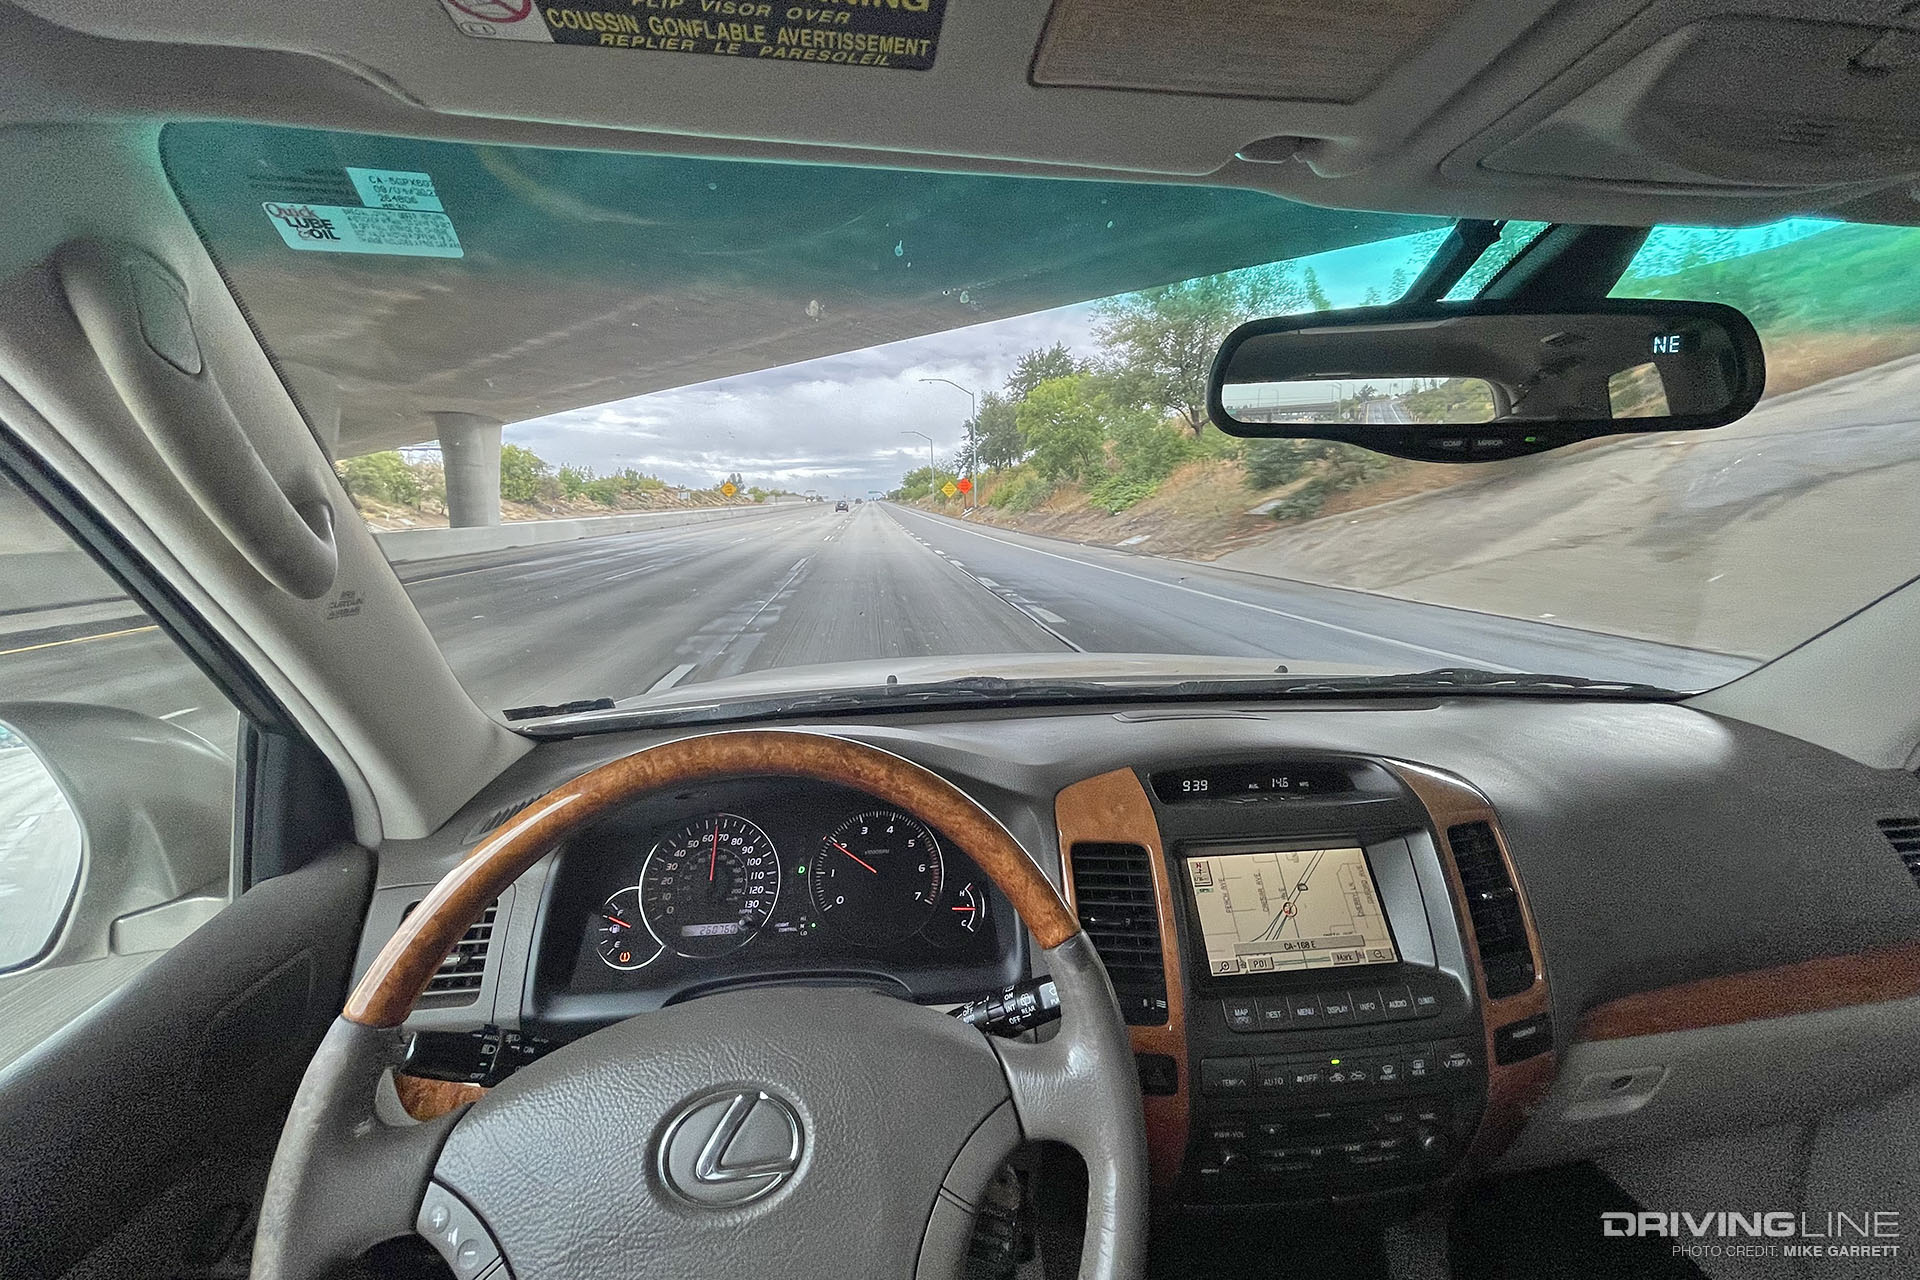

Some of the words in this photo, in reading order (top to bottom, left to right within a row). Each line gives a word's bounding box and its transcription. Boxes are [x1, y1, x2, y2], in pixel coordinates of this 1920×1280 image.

[701, 0, 772, 17] VISOR
[786, 7, 850, 23] OVER
[546, 8, 640, 33] COUSSIN
[650, 16, 766, 42] GONFLABLE
[778, 26, 930, 56] AVERTISSEMENT
[600, 33, 694, 50] REPLIER
[714, 42, 741, 54] LE
[759, 46, 890, 66] PARESOLEIL
[266, 203, 320, 220] Quick
[282, 216, 335, 228] LUBE
[1654, 336, 1680, 354] NE
[718, 834, 729, 842] 70
[731, 837, 742, 846] 80
[742, 846, 753, 854] 90
[747, 858, 762, 866] 100
[750, 872, 764, 880] 110
[661, 877, 673, 885] 20
[749, 886, 764, 894] 120
[836, 896, 844, 904] 0
[915, 892, 922, 900] 7
[1284, 940, 1310, 950] CA-168
[1337, 953, 1353, 961] Mark
[1253, 960, 1267, 968] POI
[1004, 992, 1014, 1000] ON
[1389, 1000, 1407, 1008] AUDIO
[963, 1006, 973, 1016] OFF
[1006, 1004, 1016, 1013] INT
[1021, 1006, 1036, 1014] REAR
[1327, 1006, 1348, 1014] DISPLAY
[1266, 1010, 1280, 1019] DEST
[1009, 1016, 1021, 1024] OFF
[1264, 1077, 1283, 1086] AUTO
[1303, 1074, 1318, 1082] OFF
